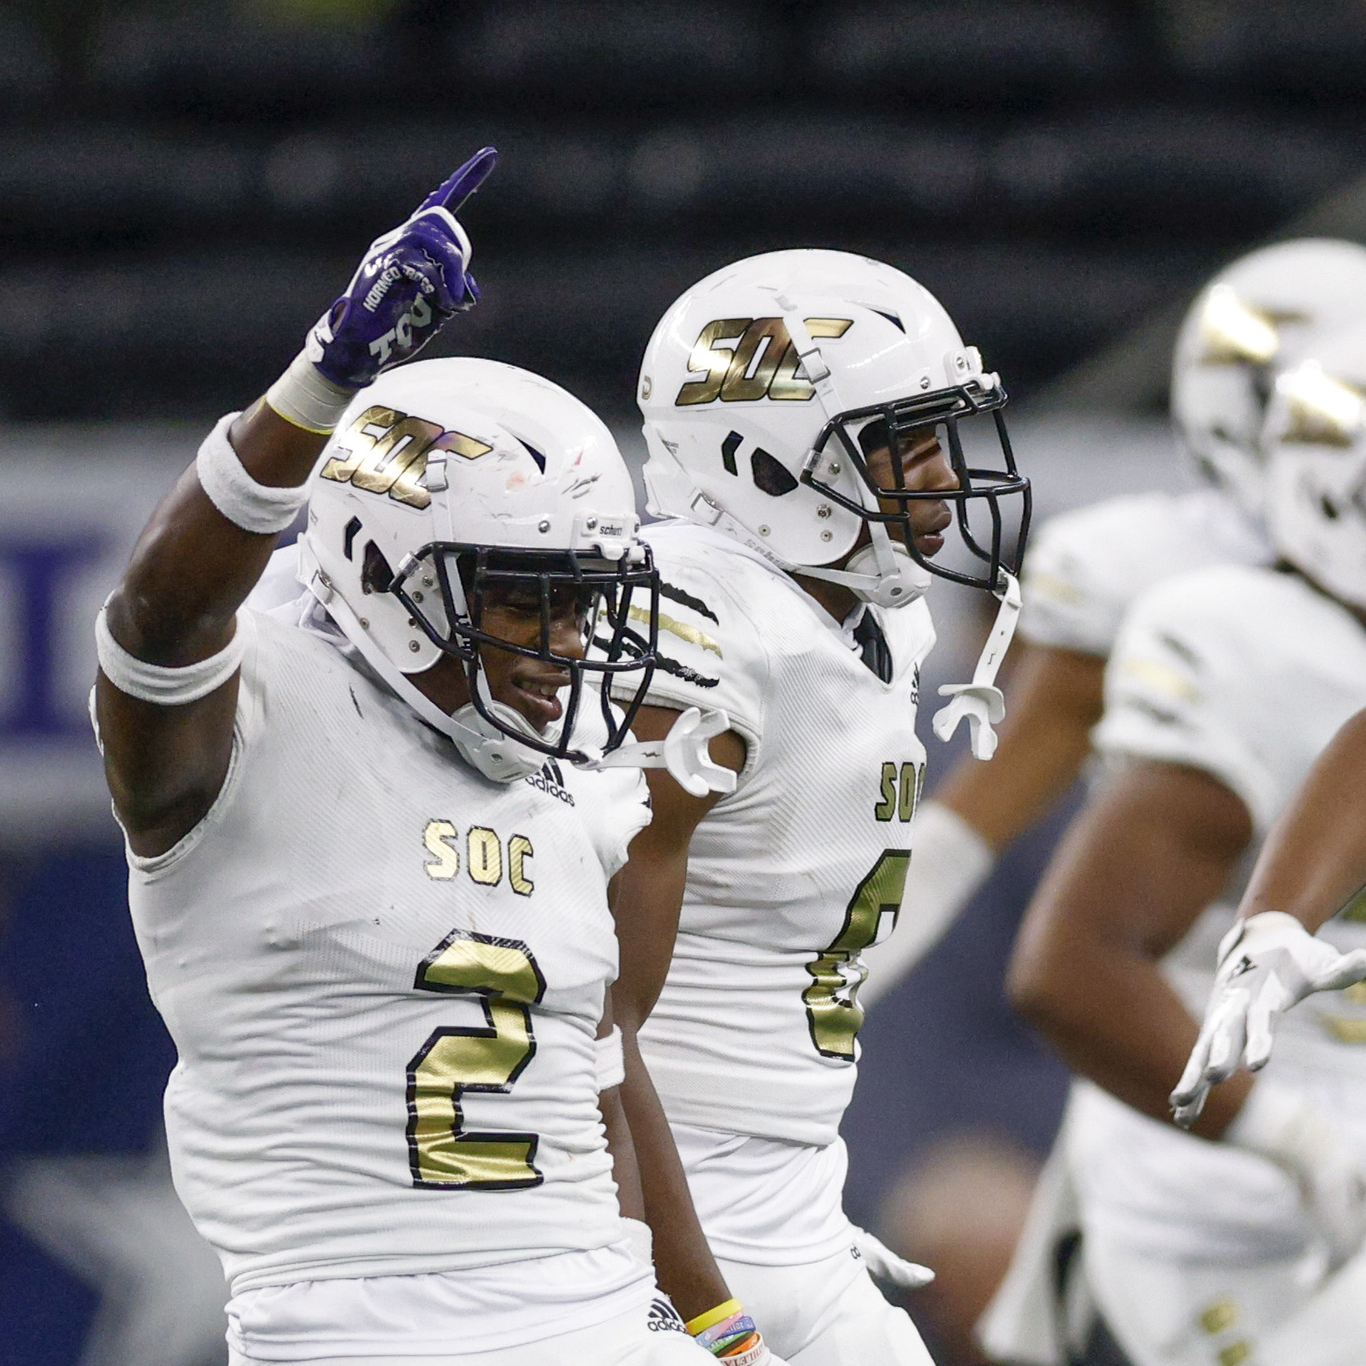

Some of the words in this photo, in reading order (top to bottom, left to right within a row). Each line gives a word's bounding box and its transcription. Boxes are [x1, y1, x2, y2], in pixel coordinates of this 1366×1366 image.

[675, 317, 854, 406] SOC
[320, 405, 493, 510] SOC
[525, 776, 575, 807] adidas
[423, 818, 534, 898] SOC
[405, 927, 547, 1190] 2
